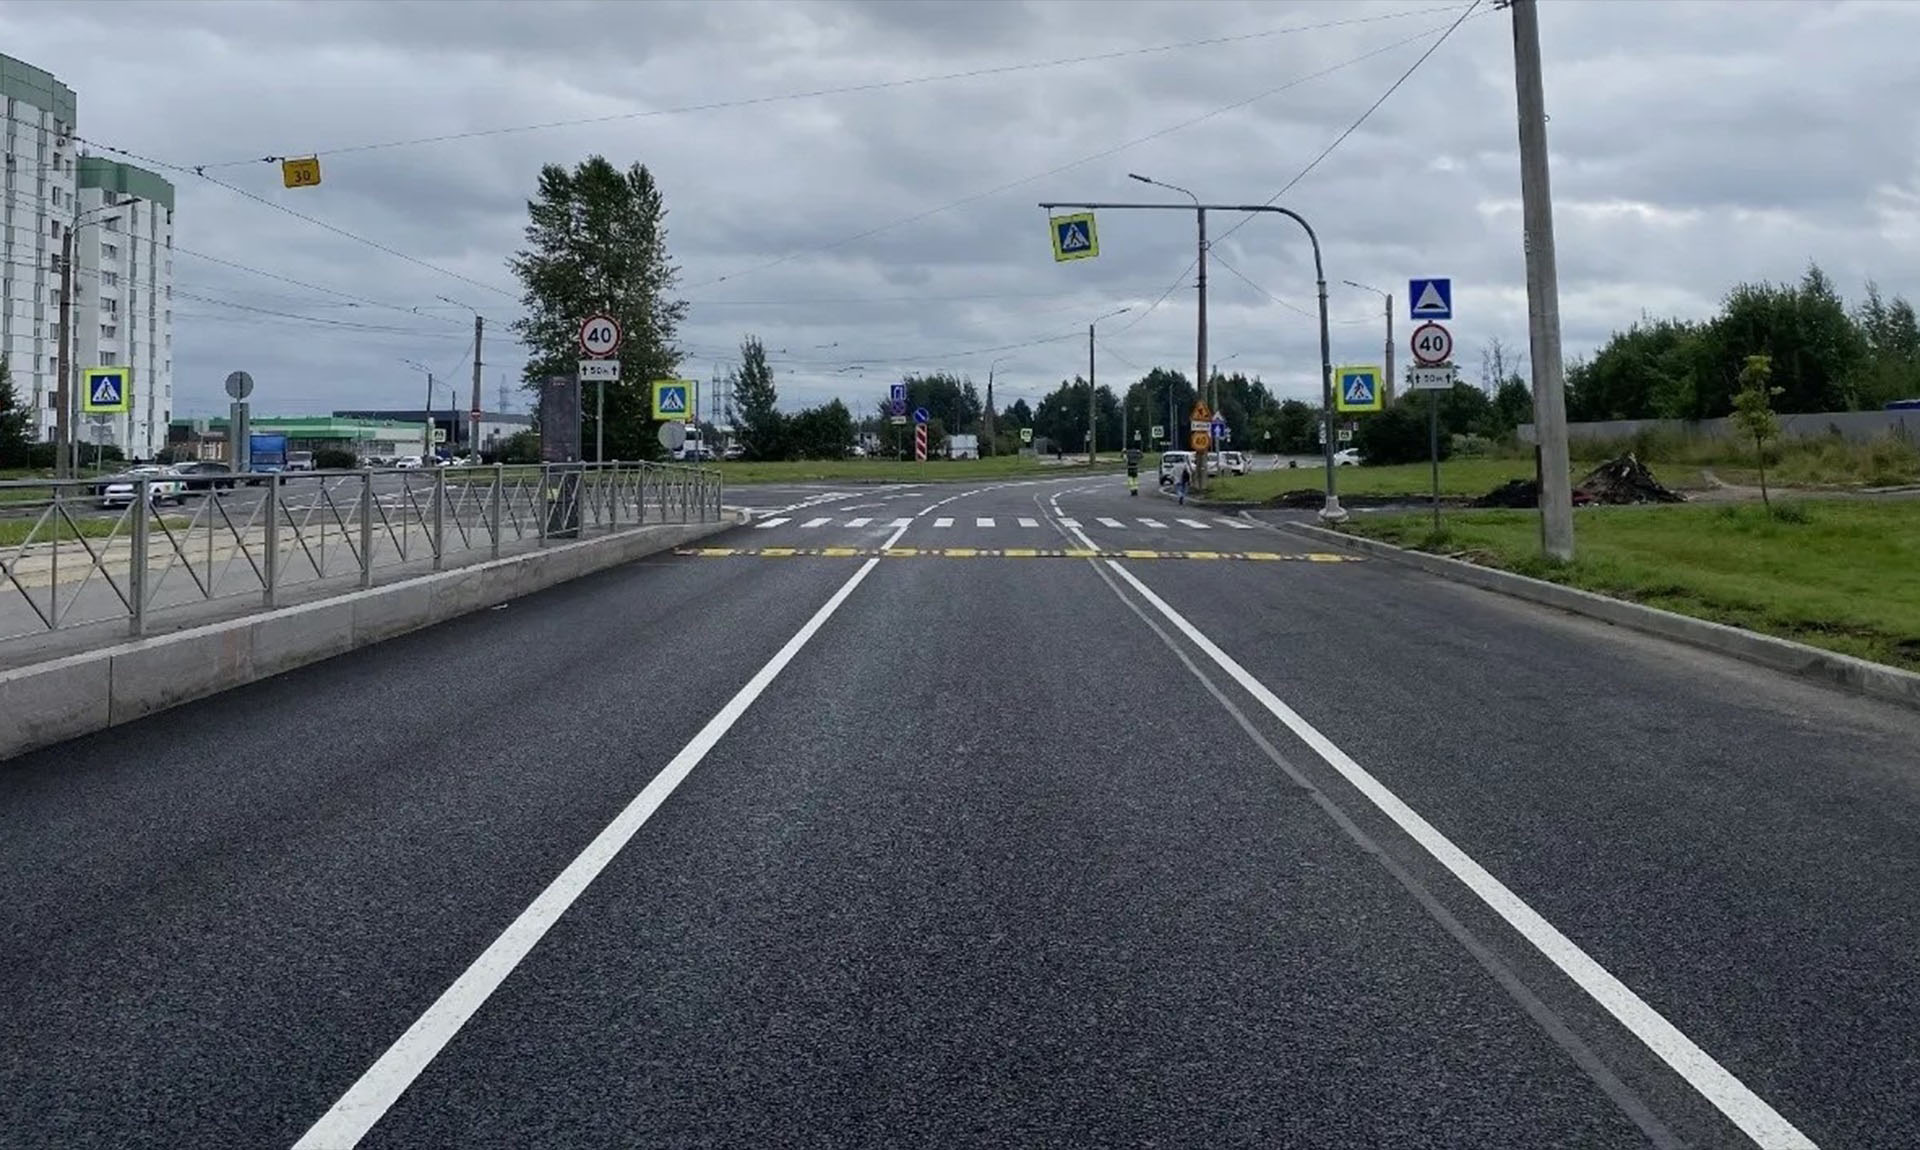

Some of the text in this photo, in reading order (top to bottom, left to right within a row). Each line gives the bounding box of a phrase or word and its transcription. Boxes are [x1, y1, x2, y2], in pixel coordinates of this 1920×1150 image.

[294, 170, 311, 183] 30
[587, 327, 611, 343] 40
[1420, 336, 1443, 351] 40
